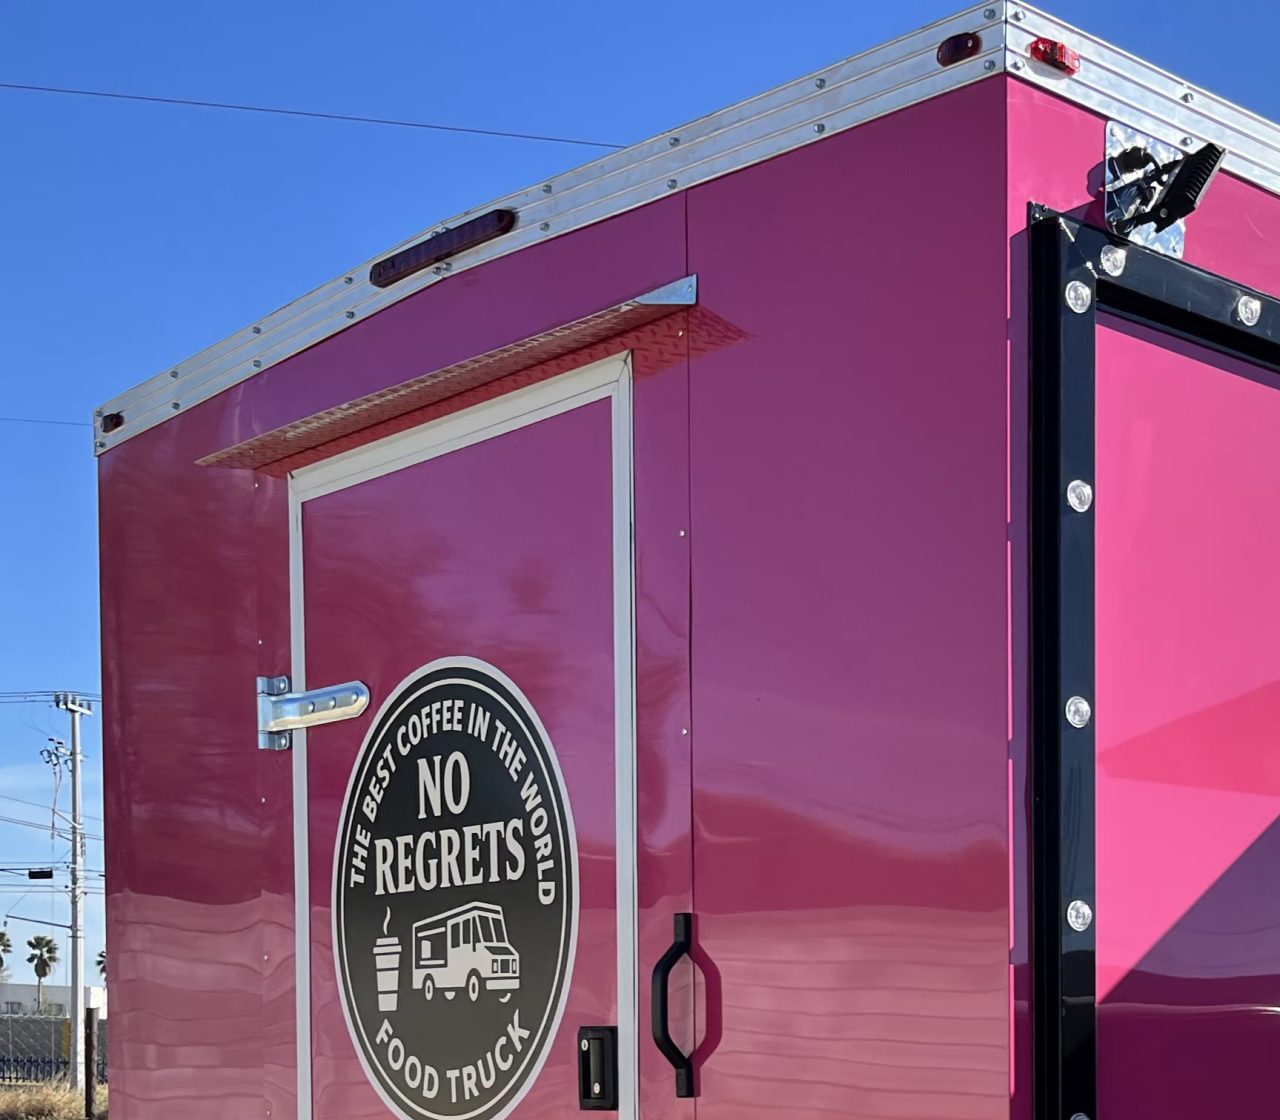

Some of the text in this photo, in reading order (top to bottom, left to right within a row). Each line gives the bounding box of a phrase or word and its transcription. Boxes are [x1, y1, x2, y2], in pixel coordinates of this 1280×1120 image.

[350, 699, 556, 905] THE BEST COFFEE IN THE WORLD
[417, 750, 471, 820] NO
[374, 817, 526, 896] REGRETS
[375, 1008, 531, 1103] FOOD TRUCK
